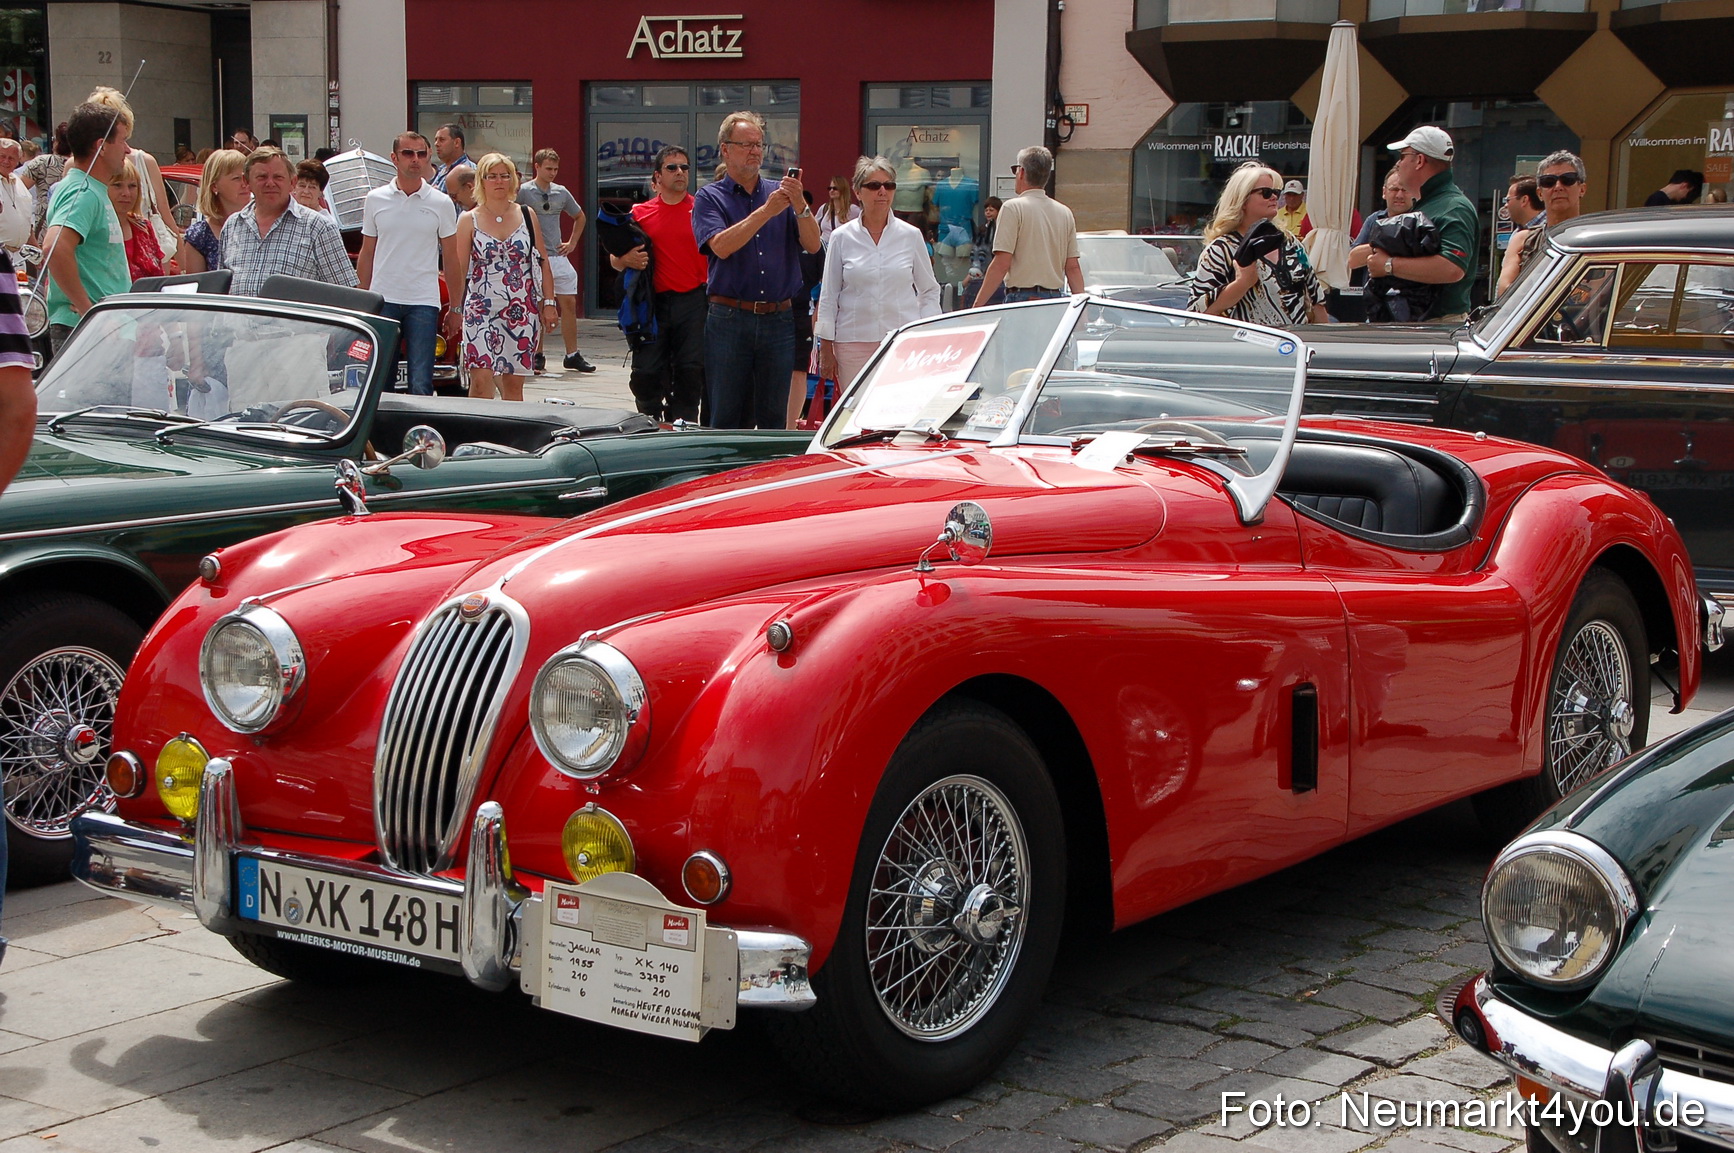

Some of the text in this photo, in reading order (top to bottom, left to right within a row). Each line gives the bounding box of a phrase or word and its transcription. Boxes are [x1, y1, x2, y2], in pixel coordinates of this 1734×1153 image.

[626, 14, 743, 58] Achatz
[98, 51, 112, 64] 22
[457, 115, 495, 129] Achatz
[906, 128, 950, 143] Achatz
[1629, 127, 1734, 152] Willkommen im RA
[1148, 142, 1200, 150] Willkommen
[1201, 142, 1212, 150] im
[1214, 135, 1260, 157] RACKL
[1706, 163, 1729, 173] SALE
[899, 345, 963, 372] Merks
[260, 867, 282, 918] N
[246, 894, 254, 908] D
[276, 929, 421, 968] www.MERKS-MOTOR-MUSEUM.de
[567, 941, 601, 956] JAGUAR
[570, 957, 594, 968] 1955
[659, 962, 679, 973] 140
[571, 970, 588, 982] 210
[639, 972, 666, 984] 3795
[580, 987, 586, 998] 6
[652, 987, 671, 998] 210
[636, 1000, 663, 1013] HEUTE
[664, 1006, 701, 1021] AUSGANG
[611, 1006, 640, 1019] MORGEN
[672, 1018, 700, 1031] MUSEUM
